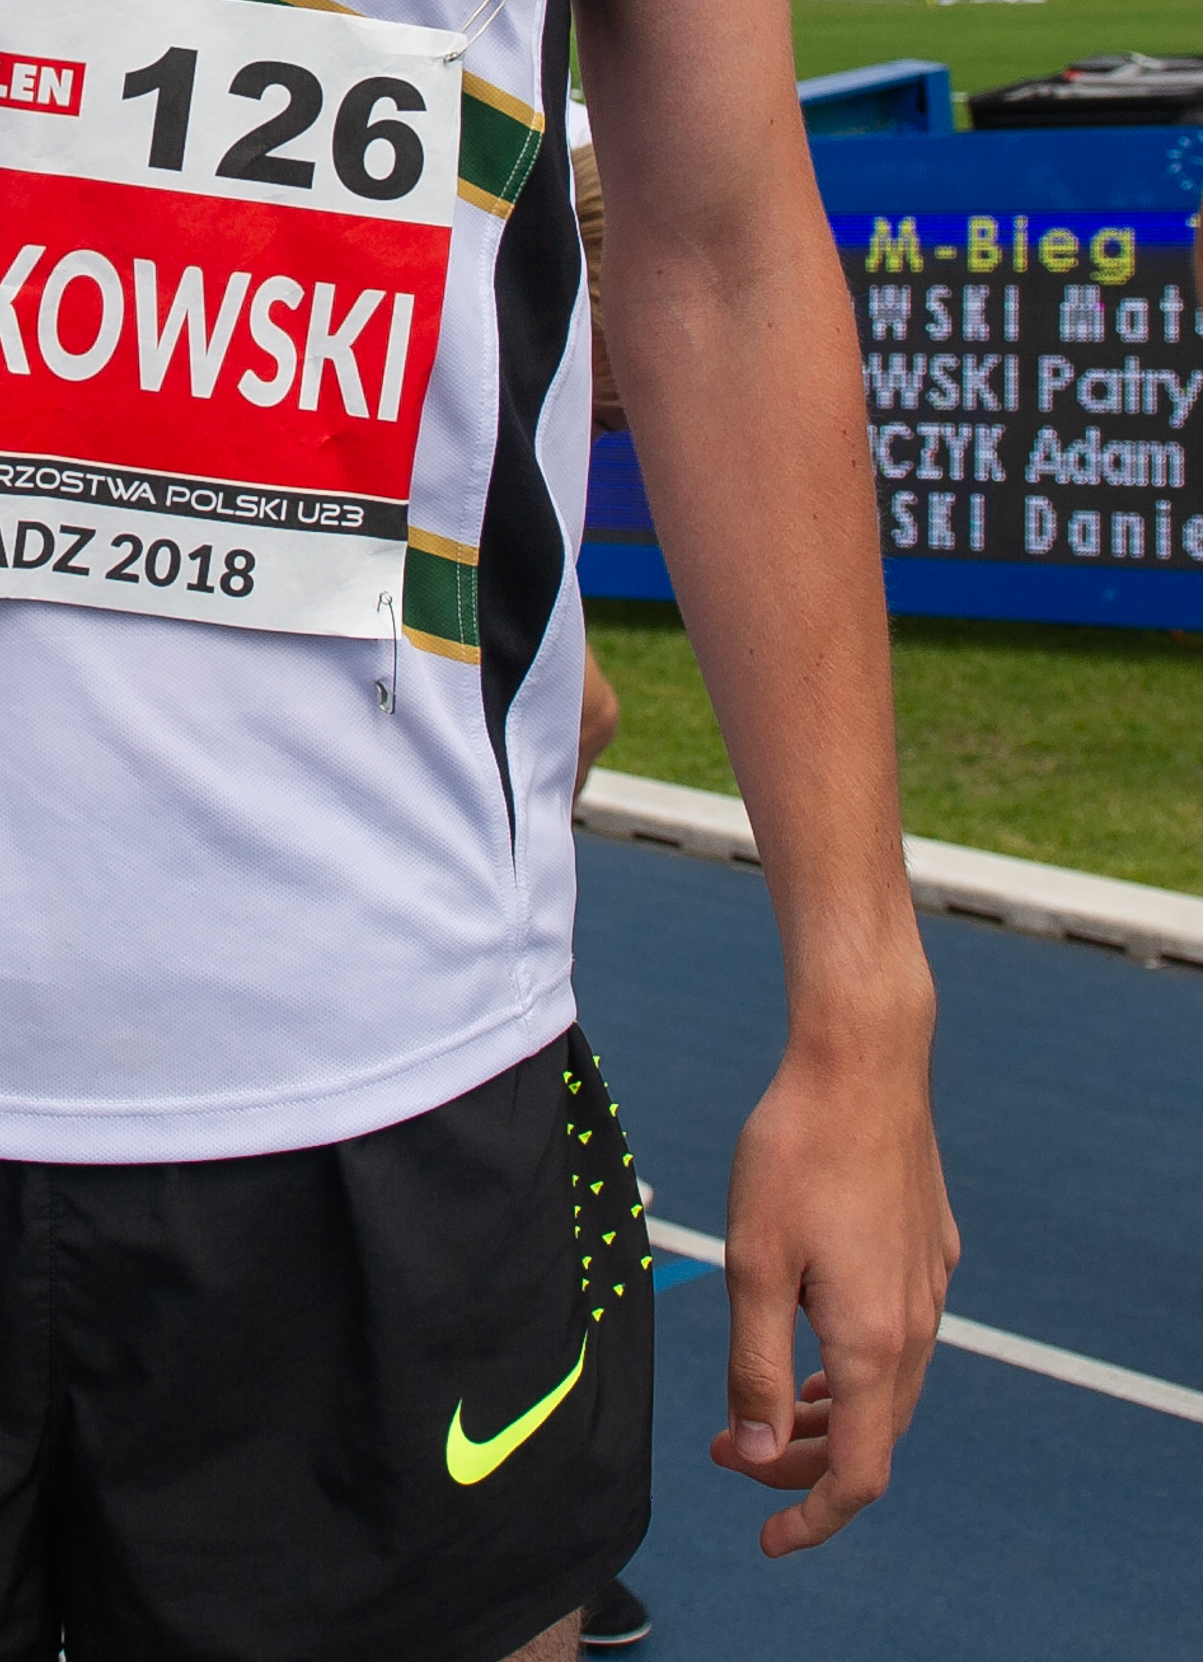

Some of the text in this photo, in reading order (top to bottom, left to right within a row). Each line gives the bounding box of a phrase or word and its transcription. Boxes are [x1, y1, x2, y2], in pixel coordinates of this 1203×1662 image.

[121, 46, 428, 201] 126
[865, 215, 1136, 286] M-Bieg
[869, 284, 1203, 343] WSKI Mat
[862, 352, 1203, 429] WSKI Patry
[867, 421, 1186, 488] CZYK Adam
[165, 485, 287, 522] POLSKI
[297, 501, 365, 528] U23
[890, 491, 986, 551] SKI
[104, 532, 256, 598] 2018
